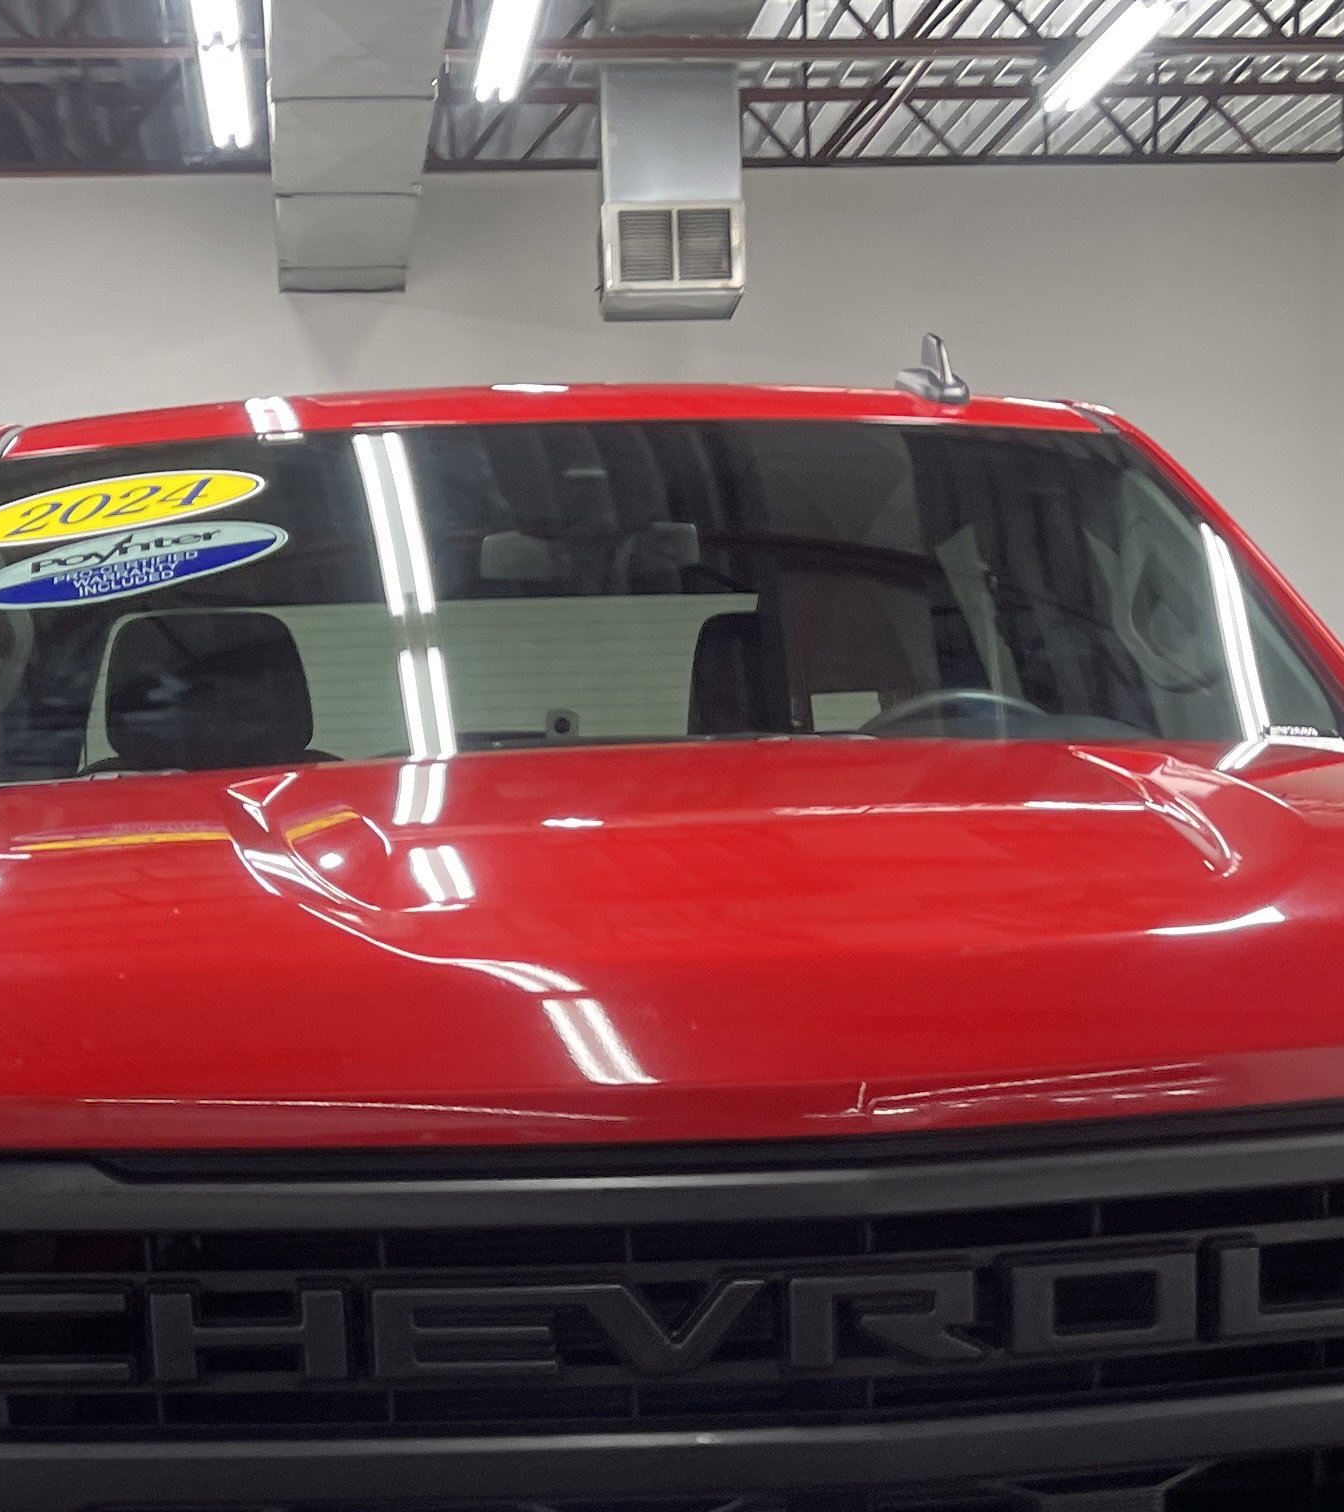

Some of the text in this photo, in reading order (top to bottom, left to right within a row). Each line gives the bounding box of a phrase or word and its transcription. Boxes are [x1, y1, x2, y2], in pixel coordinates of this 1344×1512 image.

[5, 477, 213, 537] 2024
[73, 562, 180, 588] WARRANTY
[78, 569, 175, 597] INCLUDED
